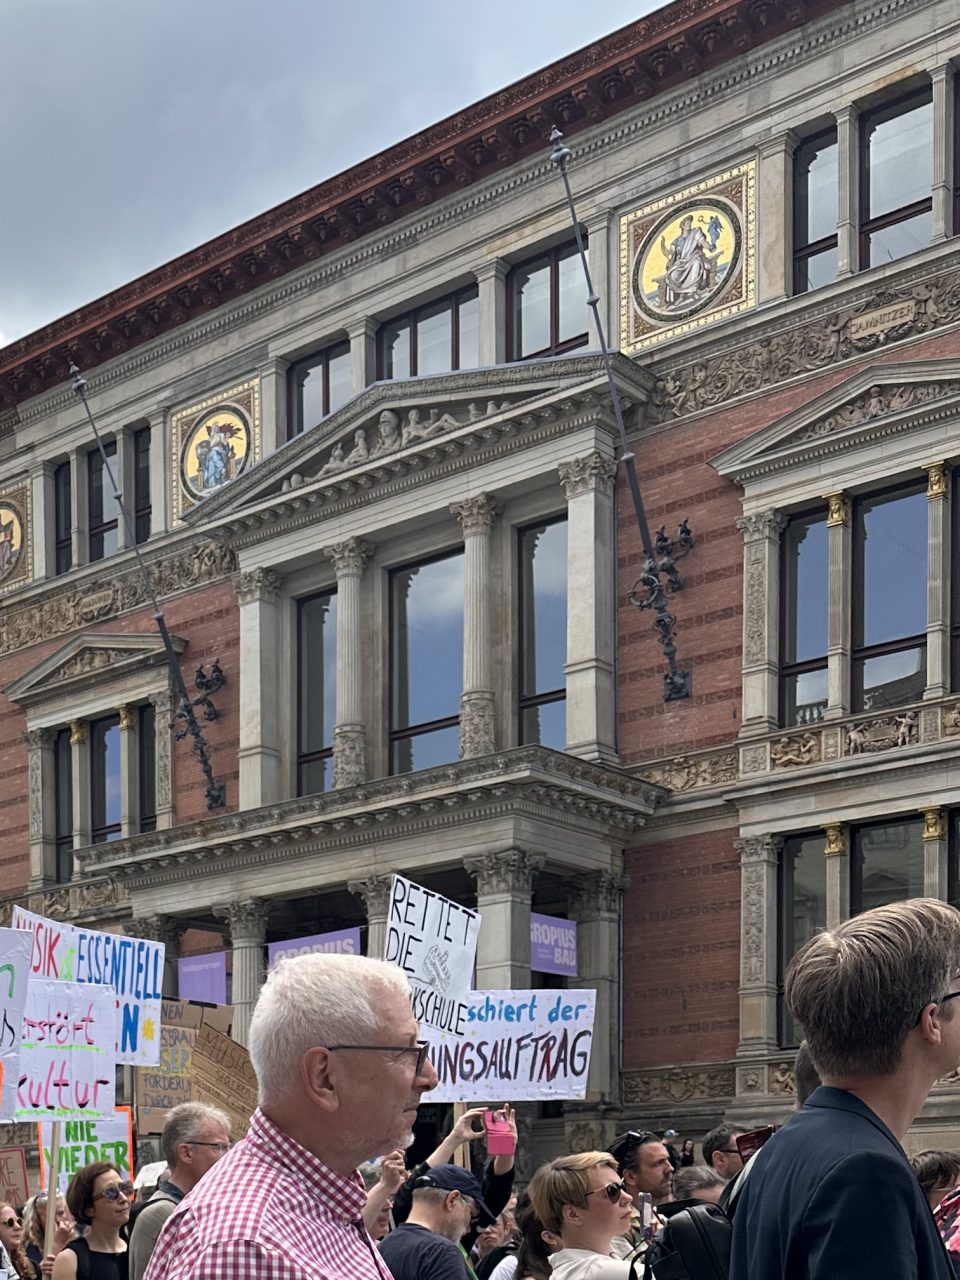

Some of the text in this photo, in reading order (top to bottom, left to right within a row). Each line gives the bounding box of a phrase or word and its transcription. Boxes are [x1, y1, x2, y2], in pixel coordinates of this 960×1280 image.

[391, 878, 476, 946] RETTET
[17, 914, 61, 979] USIK
[77, 933, 161, 999] ESSENTIELL
[386, 927, 422, 973] DIE
[531, 922, 576, 949] ROPIUS
[554, 947, 576, 966] BAU
[409, 986, 467, 1036] KSCHULE
[547, 996, 588, 1023] der
[431, 1028, 592, 1084] UNGSAUFTRAG
[66, 1120, 98, 1142] NIE
